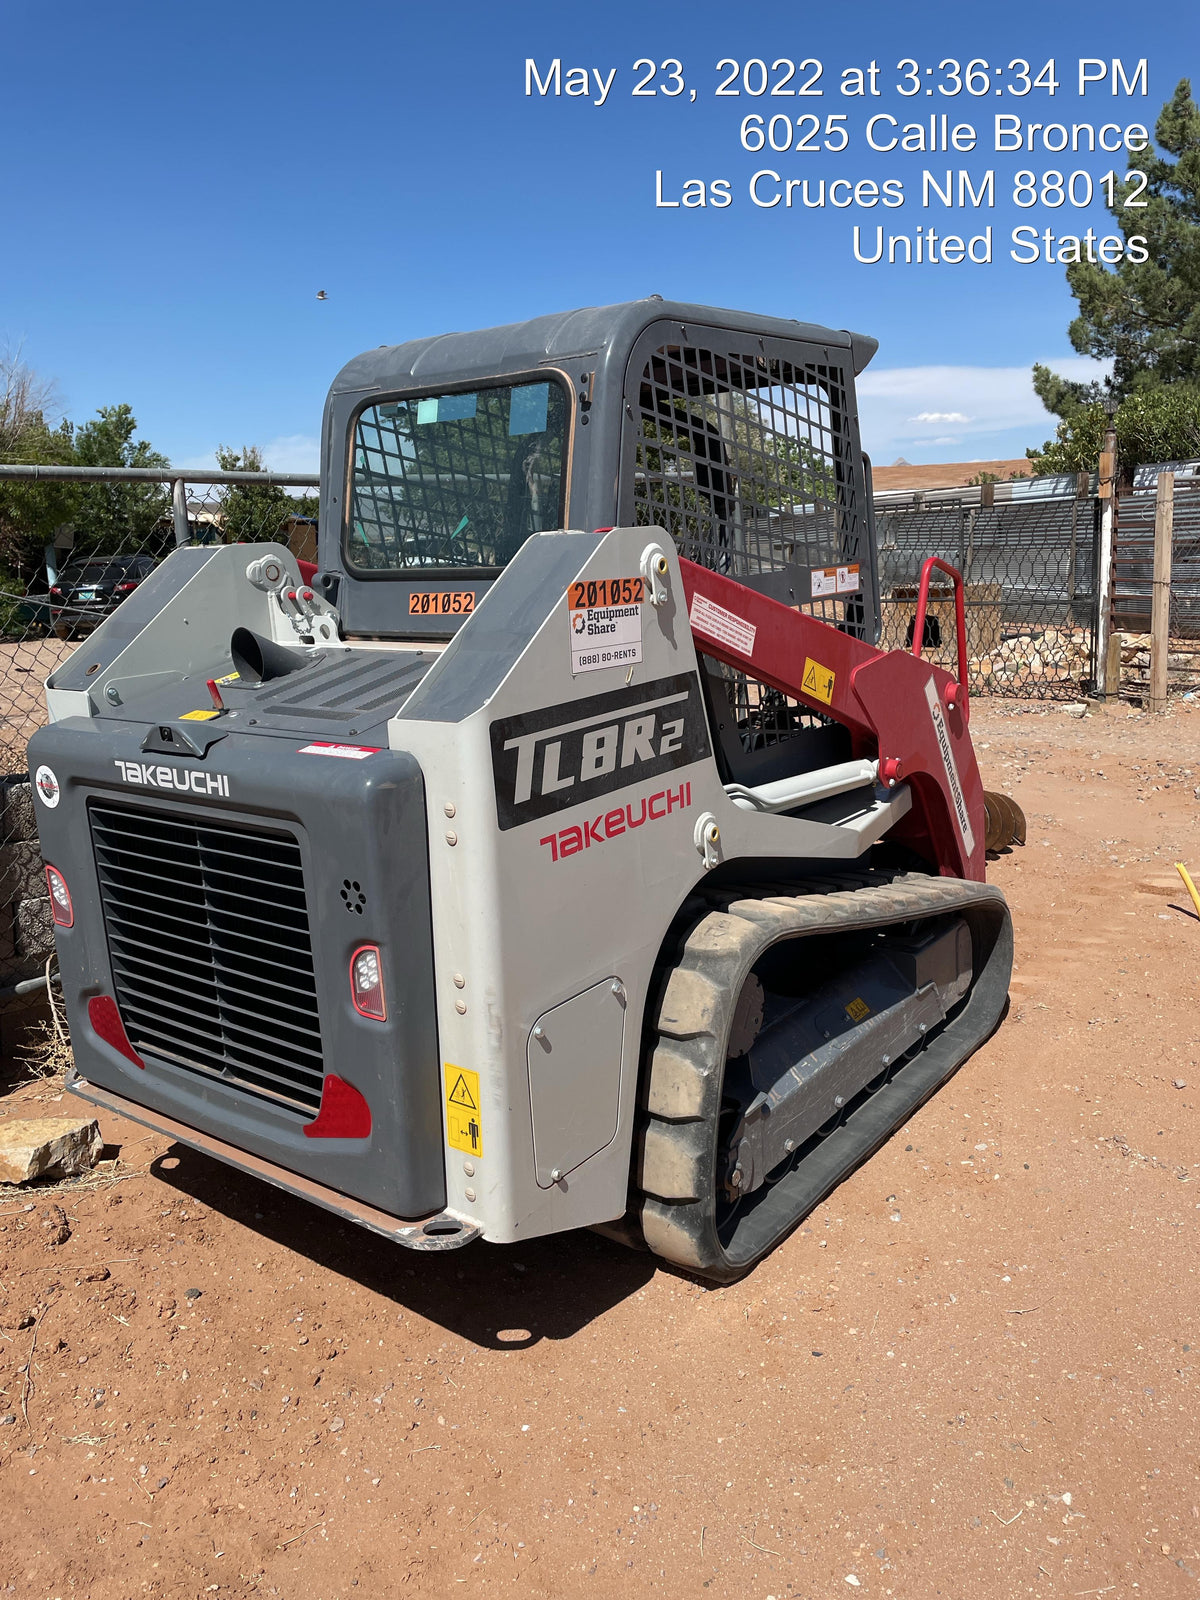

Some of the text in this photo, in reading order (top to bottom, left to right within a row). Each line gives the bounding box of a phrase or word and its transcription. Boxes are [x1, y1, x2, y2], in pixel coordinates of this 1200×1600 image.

[410, 592, 474, 614] 201052
[574, 577, 644, 608] 201052
[586, 605, 640, 623] Equipment
[587, 622, 617, 636] Share
[579, 648, 637, 666] (888) 80-RENTS
[114, 760, 230, 797] TAKEUCHI
[935, 717, 969, 834] EquipmentShare
[539, 781, 692, 863] TAKEUCHI
